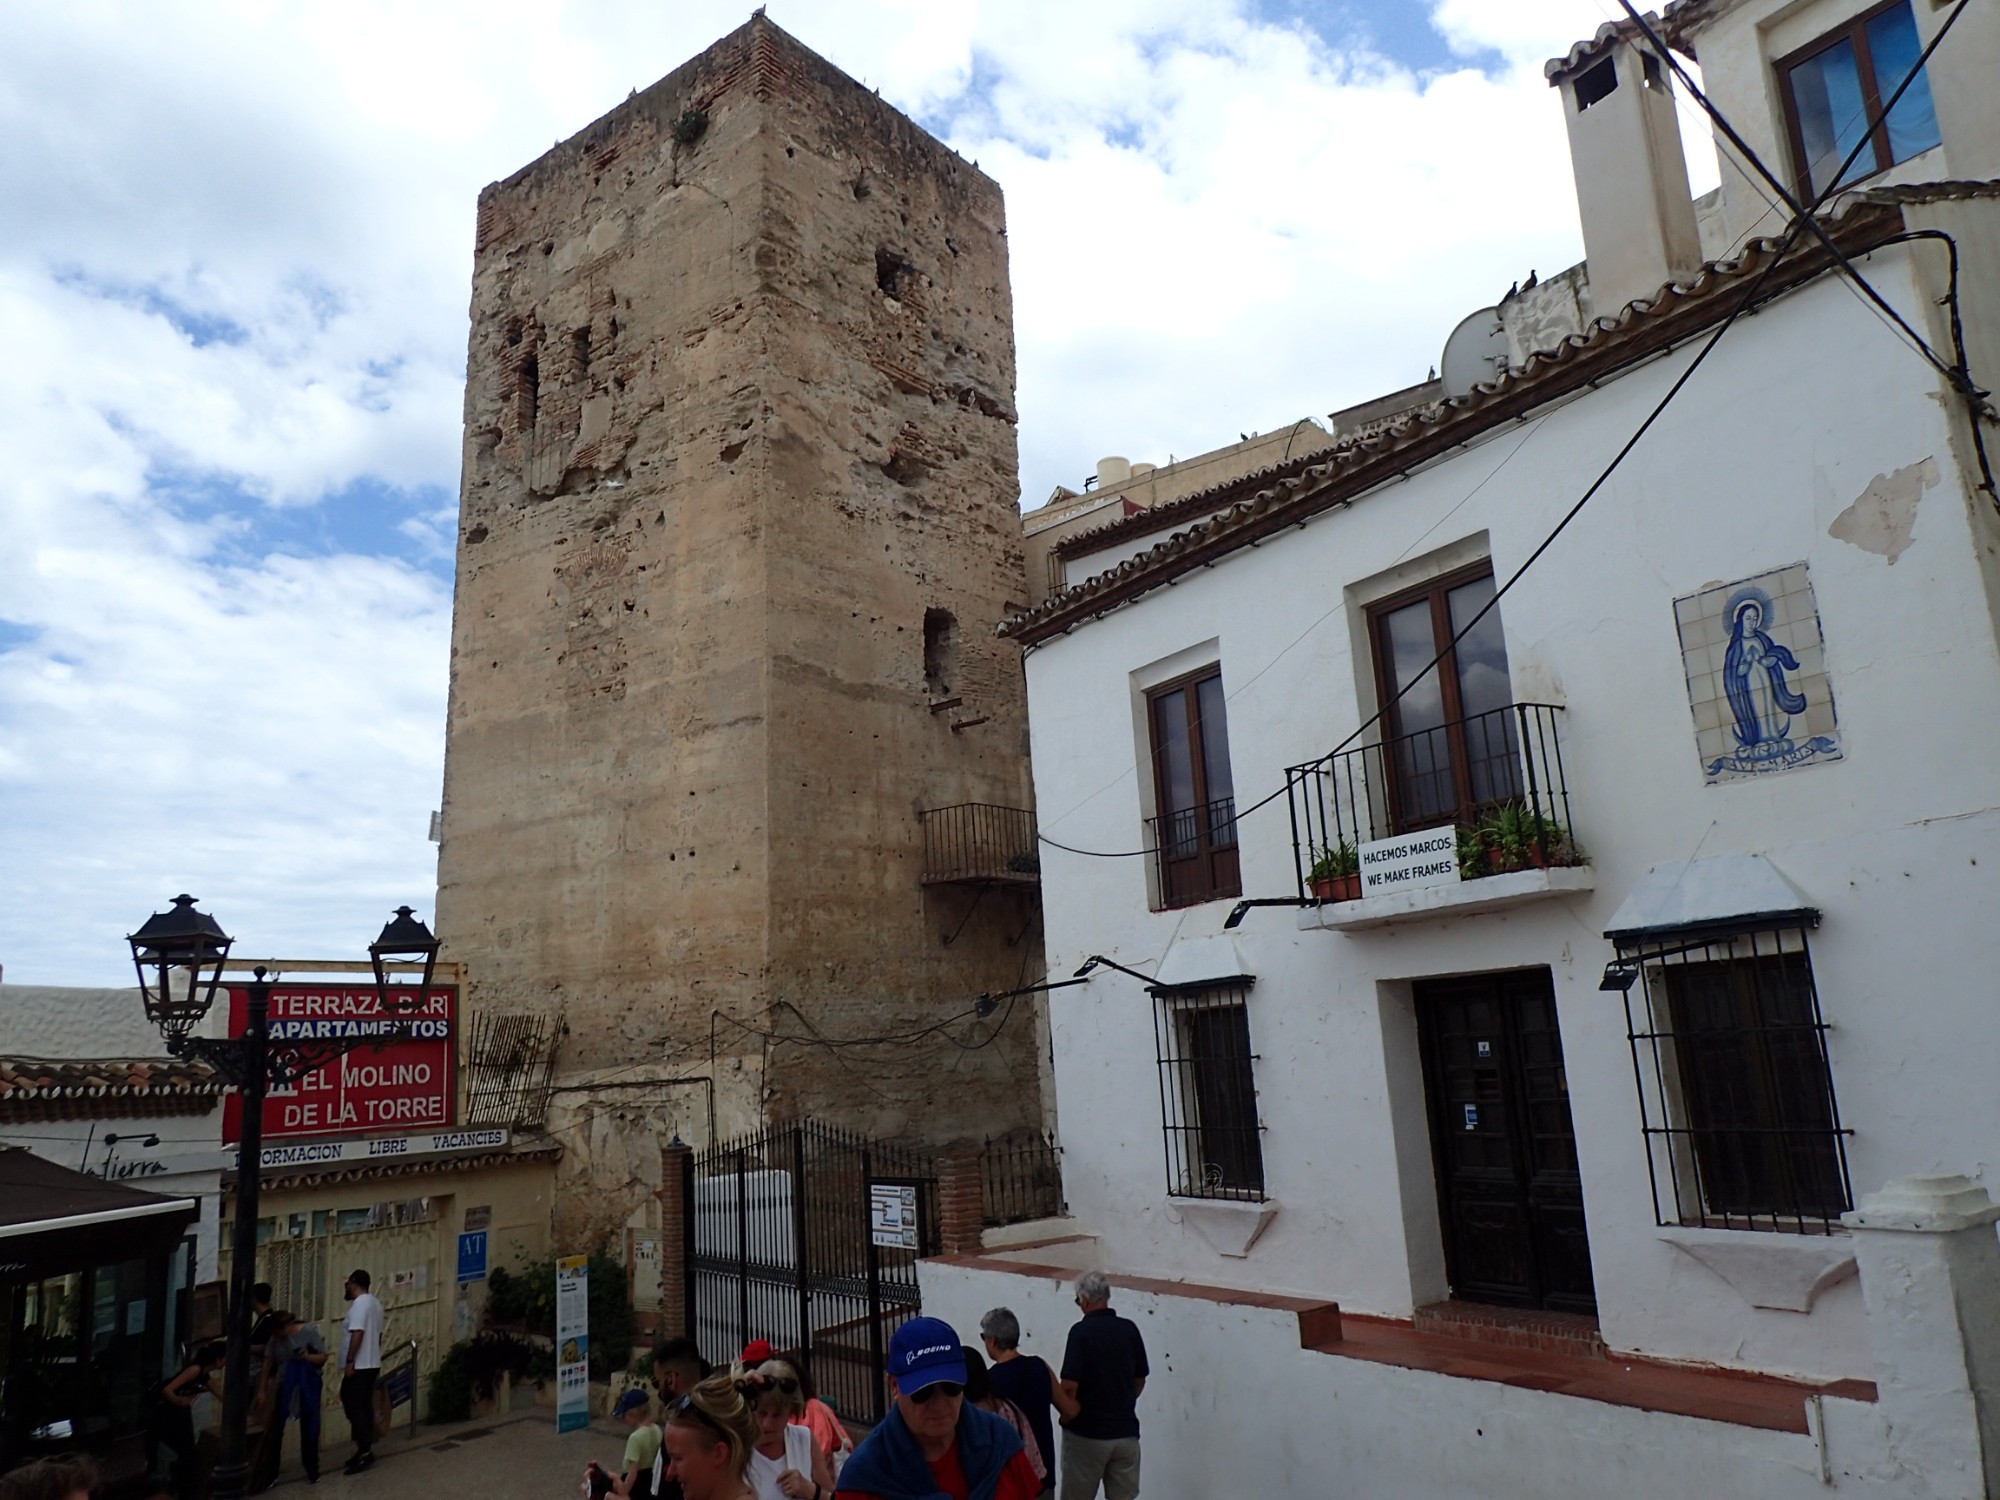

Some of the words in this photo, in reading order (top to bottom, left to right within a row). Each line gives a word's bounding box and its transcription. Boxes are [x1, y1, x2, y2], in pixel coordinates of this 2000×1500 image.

[1363, 845, 1408, 865] HACEMOS
[1409, 836, 1452, 855] MARCOS
[1367, 873, 1383, 887] WE
[1384, 868, 1411, 884] MAKE
[1412, 860, 1452, 879] FRAMES
[272, 995, 388, 1015] TERRAZA
[302, 1068, 334, 1092] EL
[342, 1063, 431, 1089] MOLINO
[283, 1103, 318, 1128] DE
[326, 1101, 358, 1124] LA
[364, 1095, 443, 1121] TORRE
[235, 1144, 343, 1168] IORMACION
[368, 1139, 408, 1156] LIBRE
[432, 1131, 502, 1150] VACANCIES
[461, 1233, 484, 1256] AT
[916, 1344, 952, 1356] BOEING
